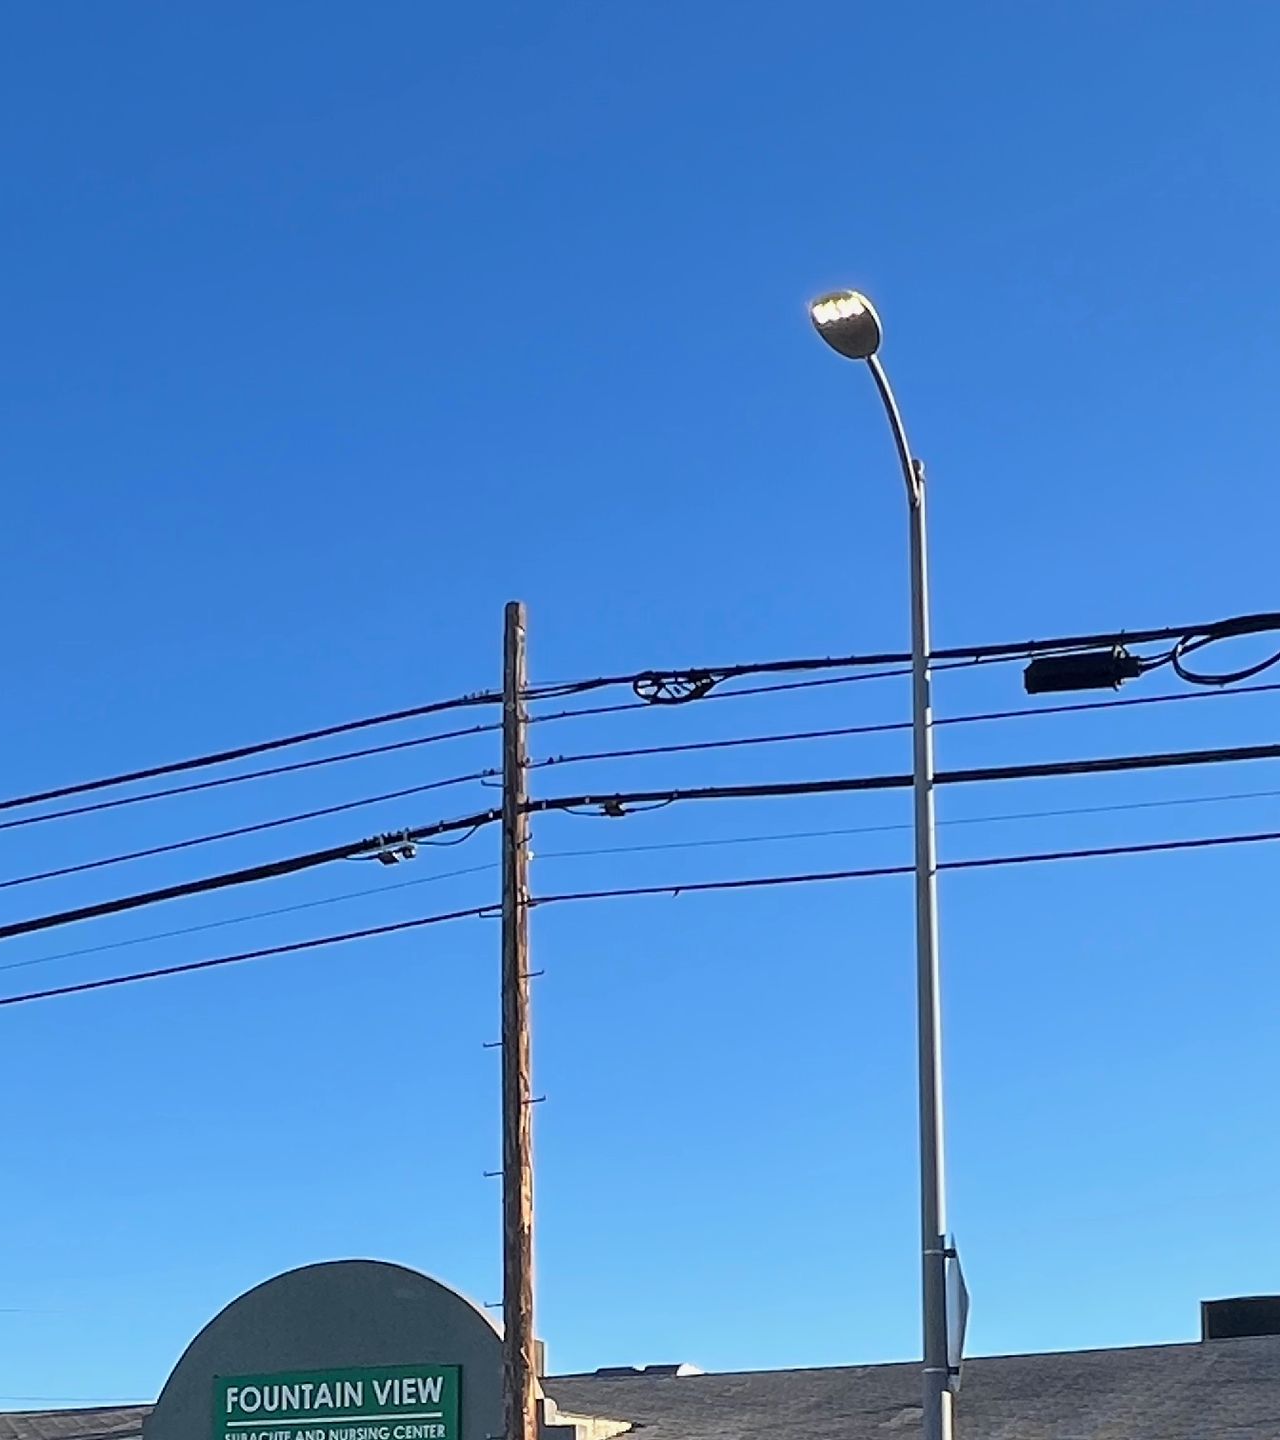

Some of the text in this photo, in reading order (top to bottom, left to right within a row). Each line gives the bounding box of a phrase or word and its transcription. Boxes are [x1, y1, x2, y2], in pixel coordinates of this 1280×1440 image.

[225, 1376, 444, 1414] FOUNTAIN VIEW
[393, 1424, 446, 1440] CENTER
